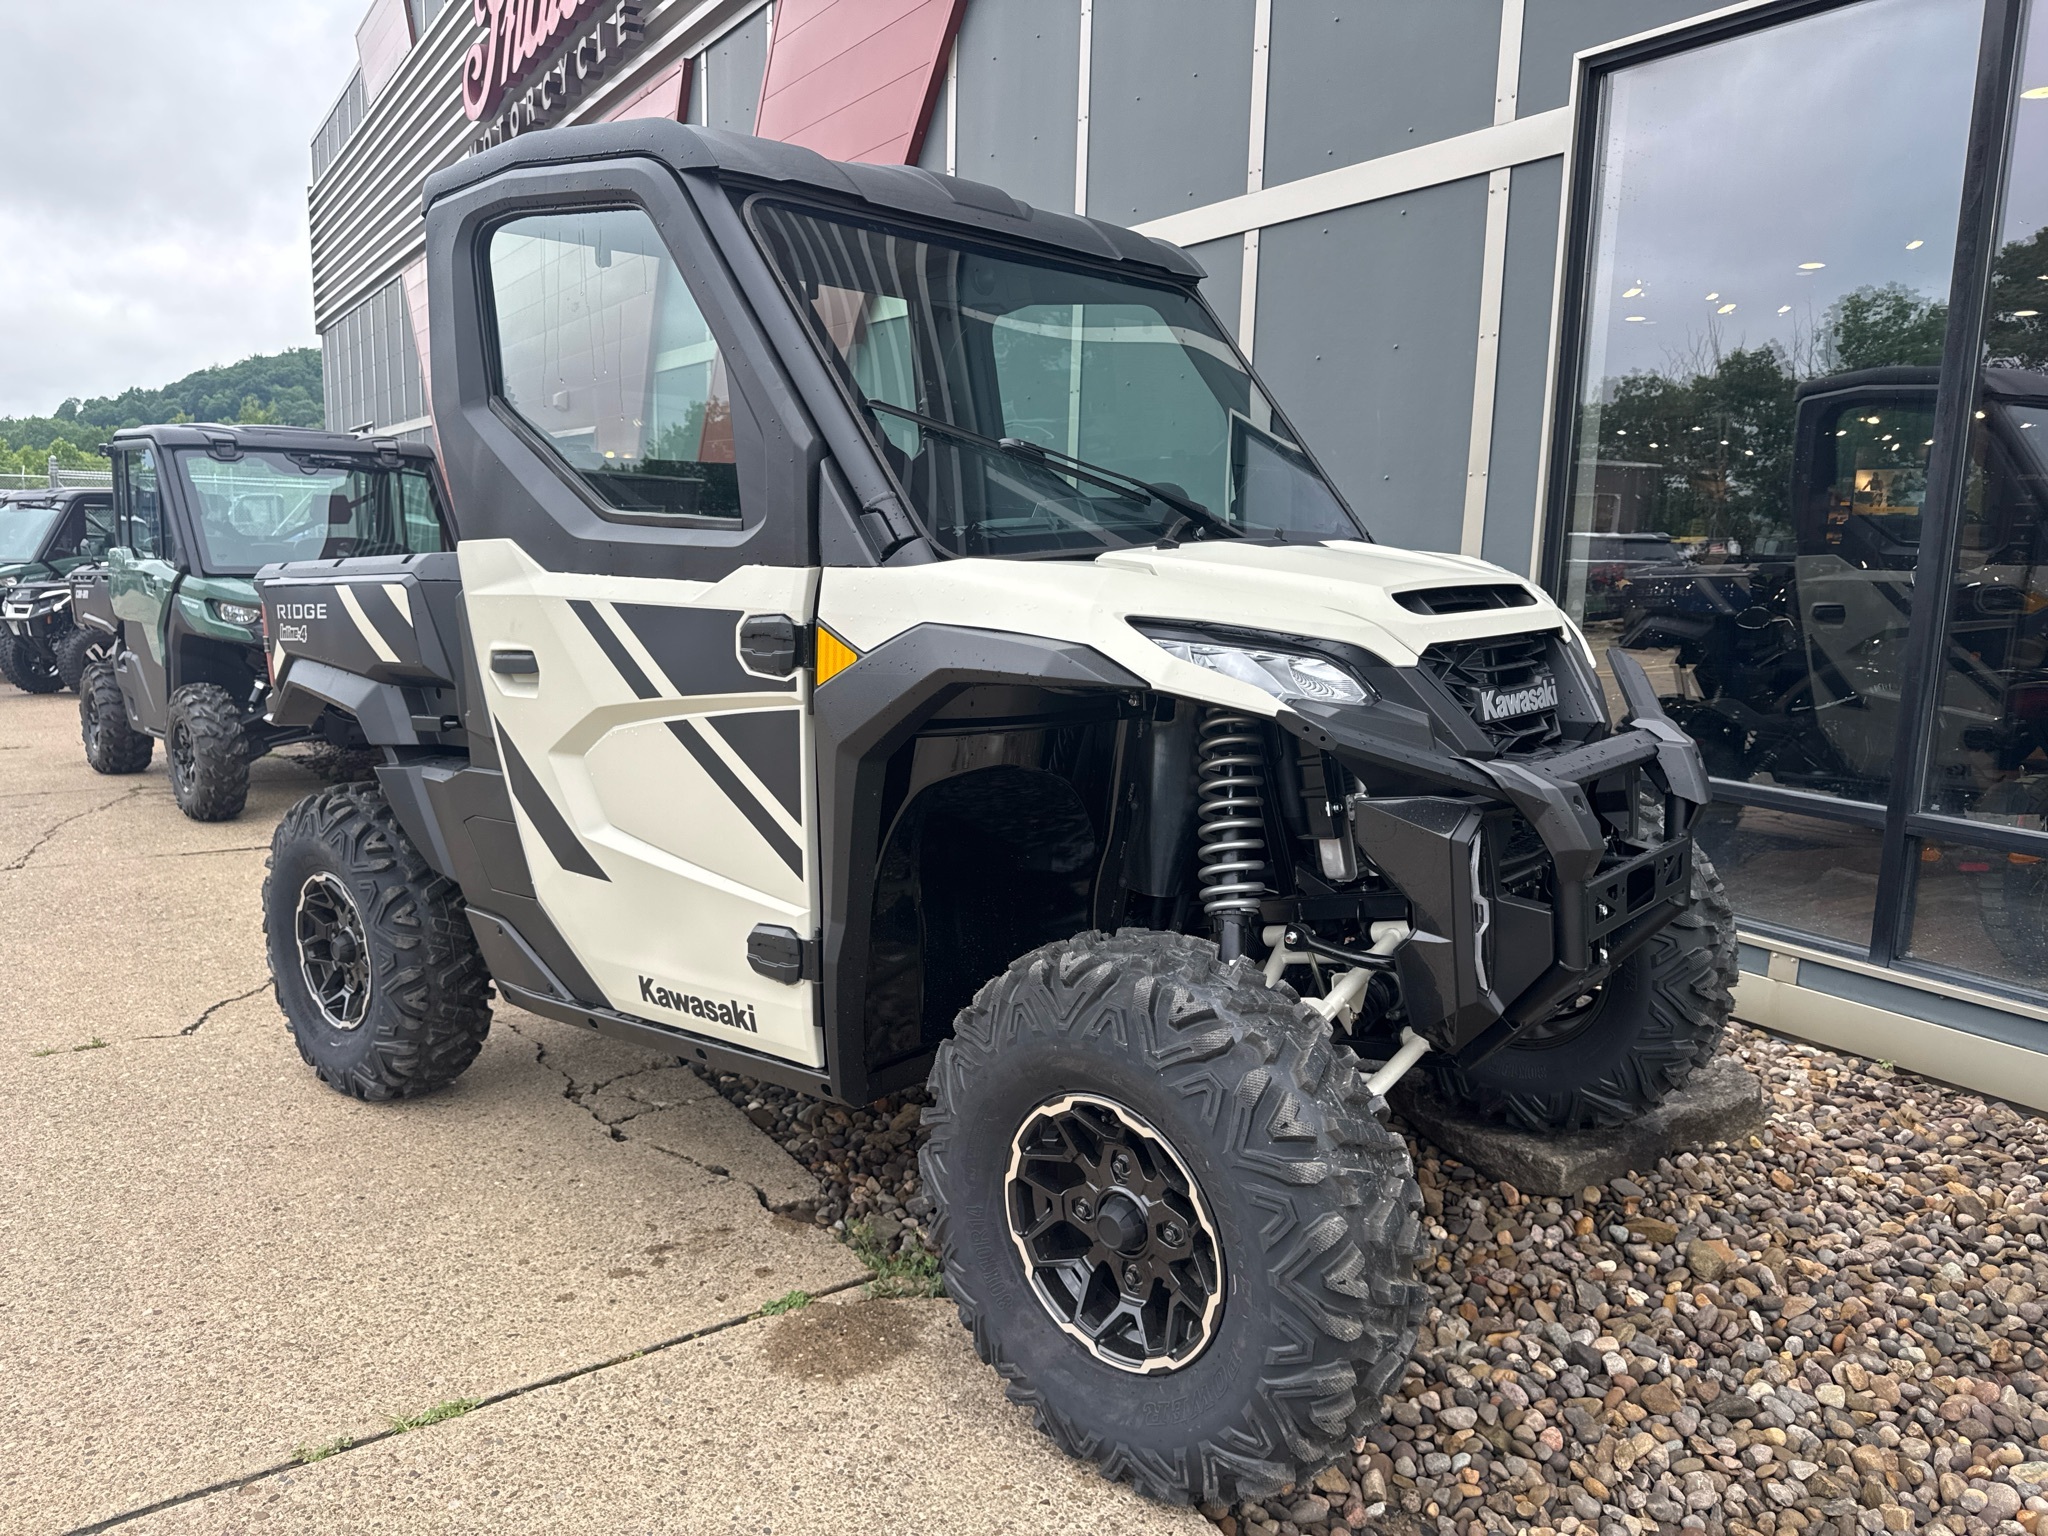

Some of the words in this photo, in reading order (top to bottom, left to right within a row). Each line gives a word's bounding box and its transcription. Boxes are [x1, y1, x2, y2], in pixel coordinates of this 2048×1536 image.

[462, 0, 587, 121] Ind
[276, 603, 328, 619] RIDGE
[1481, 677, 1559, 722] Kawasaki
[638, 975, 758, 1033] Kawasaki
[964, 1204, 1014, 1311] 30X10R14
[1142, 1340, 1243, 1427] POWER
